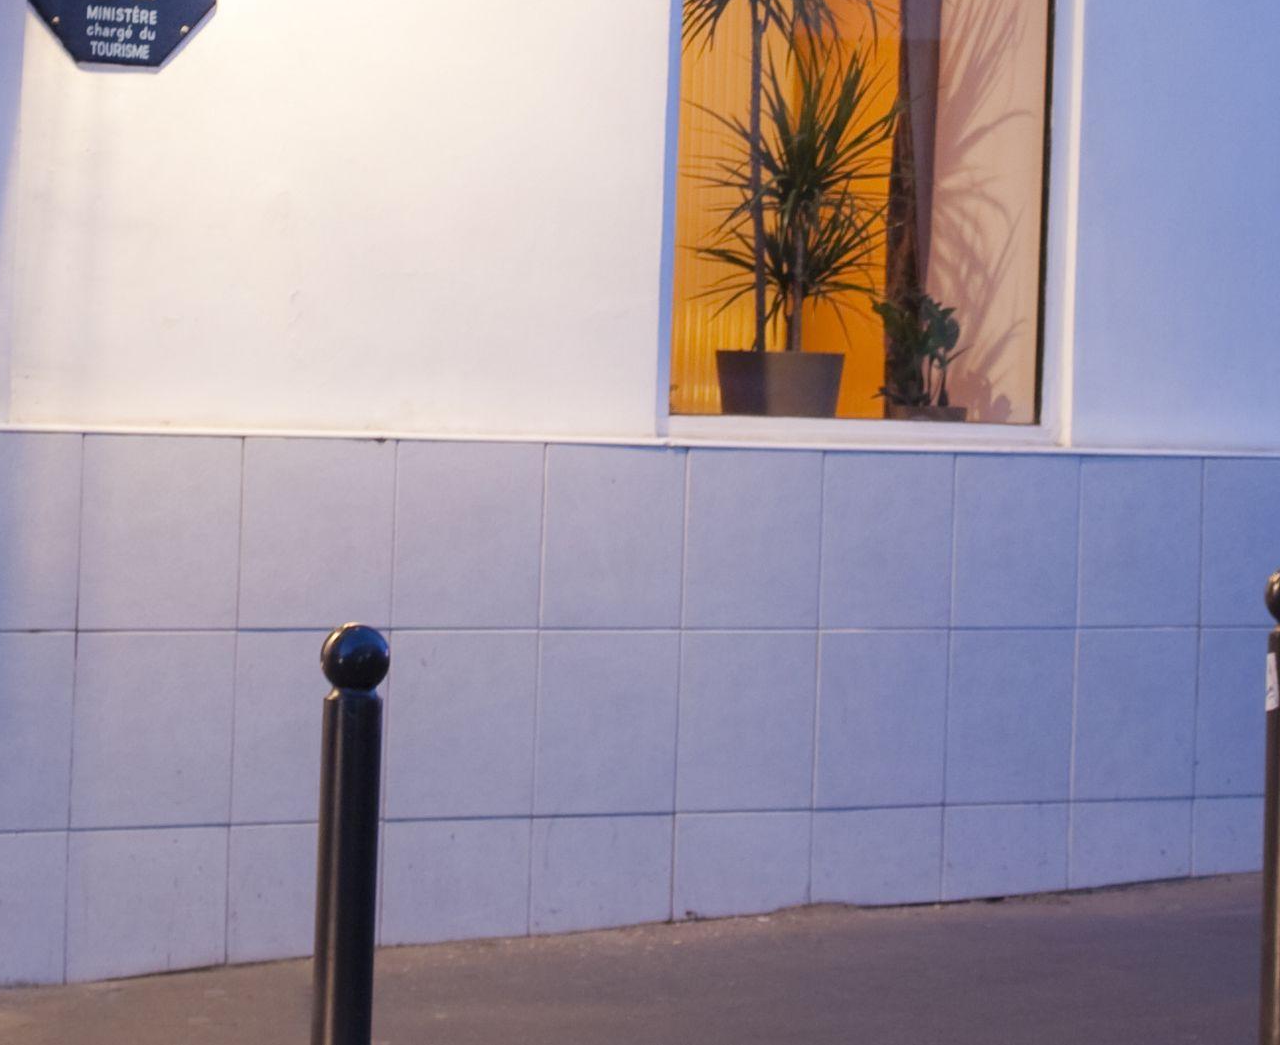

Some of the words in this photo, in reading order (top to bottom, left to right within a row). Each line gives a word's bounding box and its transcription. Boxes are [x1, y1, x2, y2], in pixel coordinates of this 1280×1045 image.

[86, 22, 133, 42] chargé
[139, 26, 156, 41] du
[90, 40, 150, 60] TOURISME
